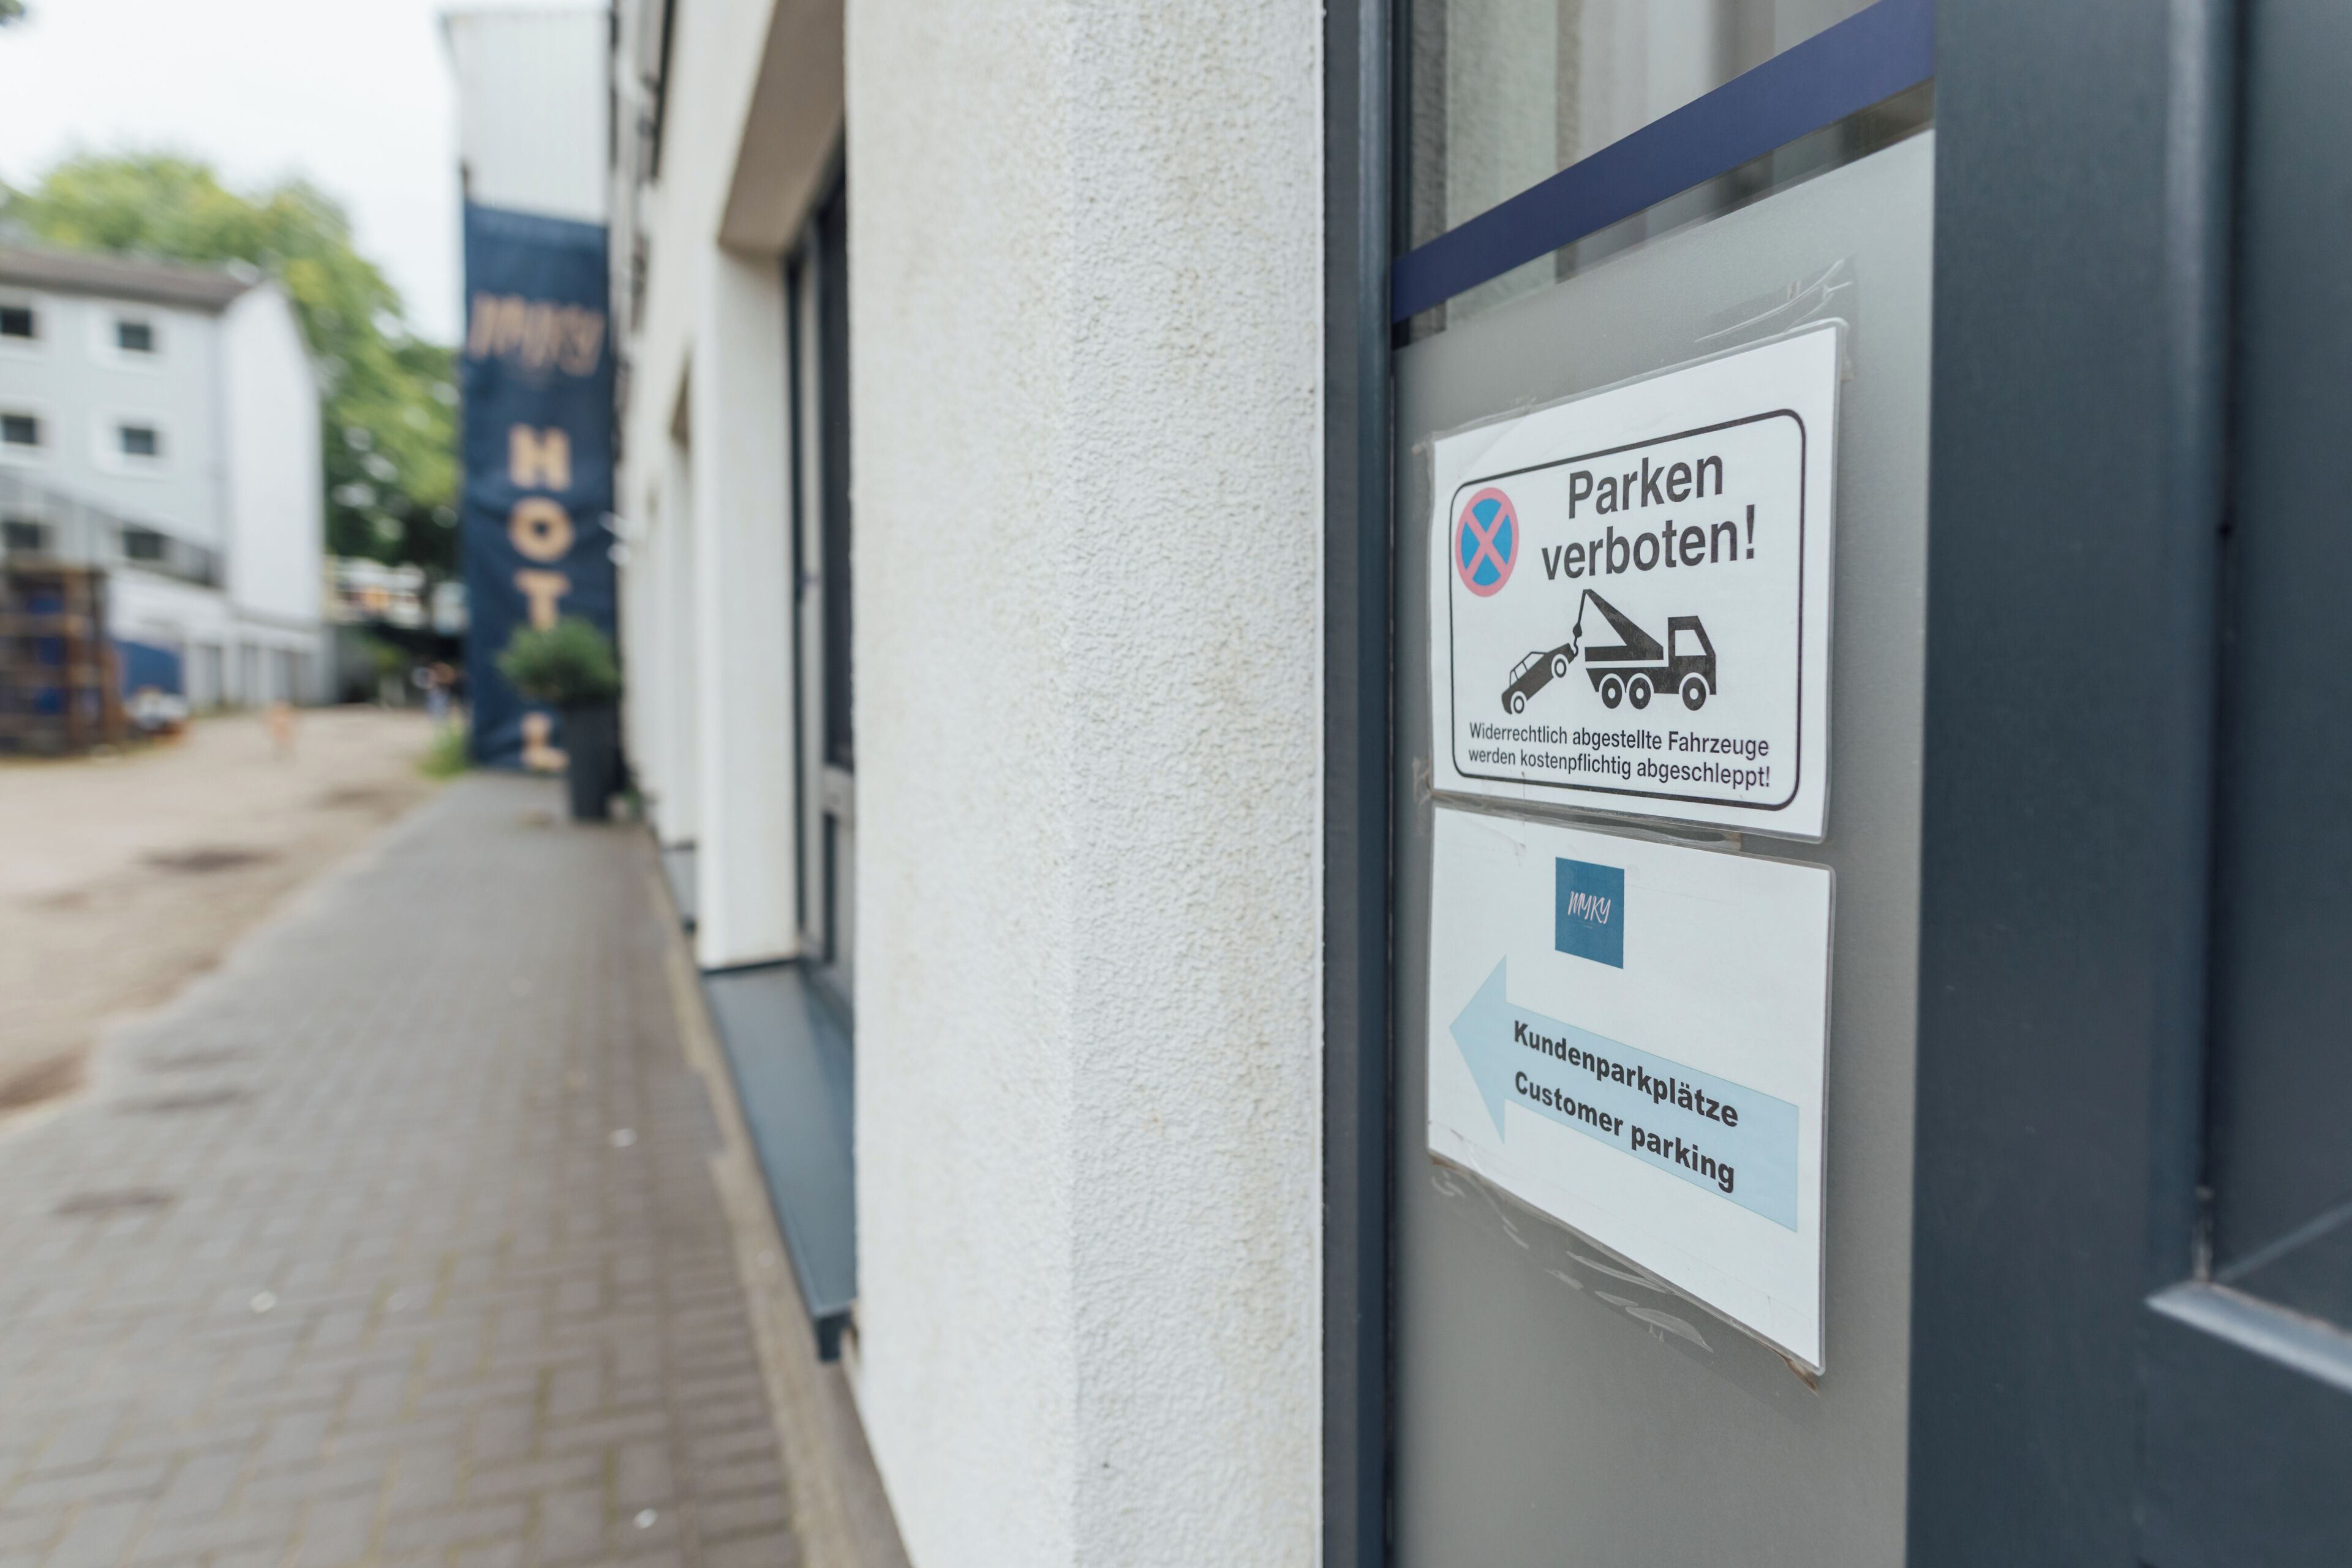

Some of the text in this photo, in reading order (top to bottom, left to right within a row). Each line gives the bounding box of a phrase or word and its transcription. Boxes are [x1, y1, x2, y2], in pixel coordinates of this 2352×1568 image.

[1567, 454, 1724, 519] Parken
[1541, 503, 1756, 580] verboten!
[507, 423, 576, 772] HOTL
[1469, 722, 1769, 761] Widerrechtlich abgestellte Fahrzeuge
[1469, 747, 1770, 791] werden kostenpflichtig abgeschleppt!
[1513, 1020, 1739, 1128] Kundenparkplätze
[1514, 1071, 1735, 1194] Customer parking
